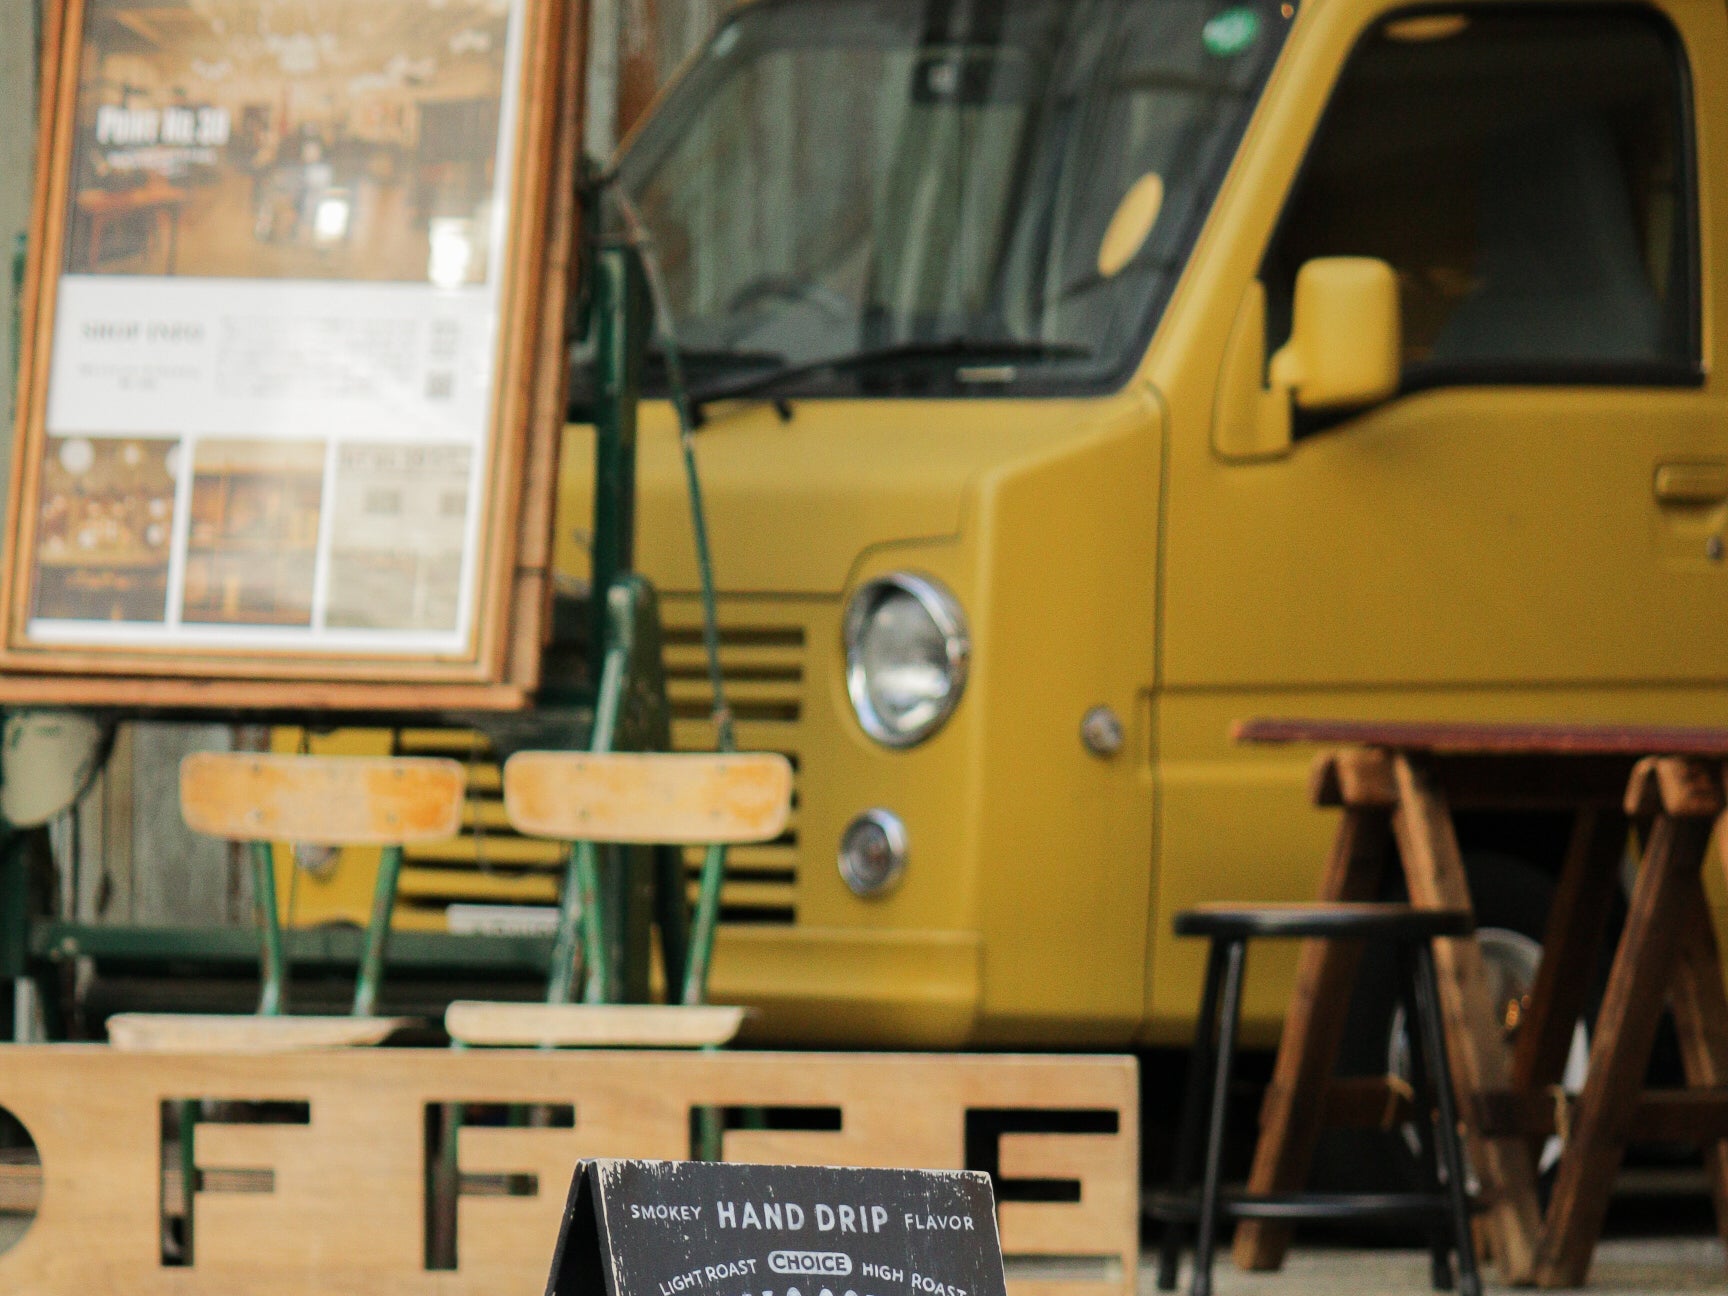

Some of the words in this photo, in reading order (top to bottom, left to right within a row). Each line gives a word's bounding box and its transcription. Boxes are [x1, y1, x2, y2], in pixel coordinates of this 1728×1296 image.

[0, 1098, 1122, 1279] FFE
[630, 1204, 701, 1221] SMOKEY
[716, 1201, 805, 1230] HAND
[815, 1203, 889, 1233] DRIP
[904, 1213, 974, 1231] FLAVOR
[658, 1268, 704, 1296] LIGHT
[704, 1259, 756, 1280] ROAST
[772, 1254, 846, 1272] CHOICE
[862, 1263, 904, 1283] HIGH
